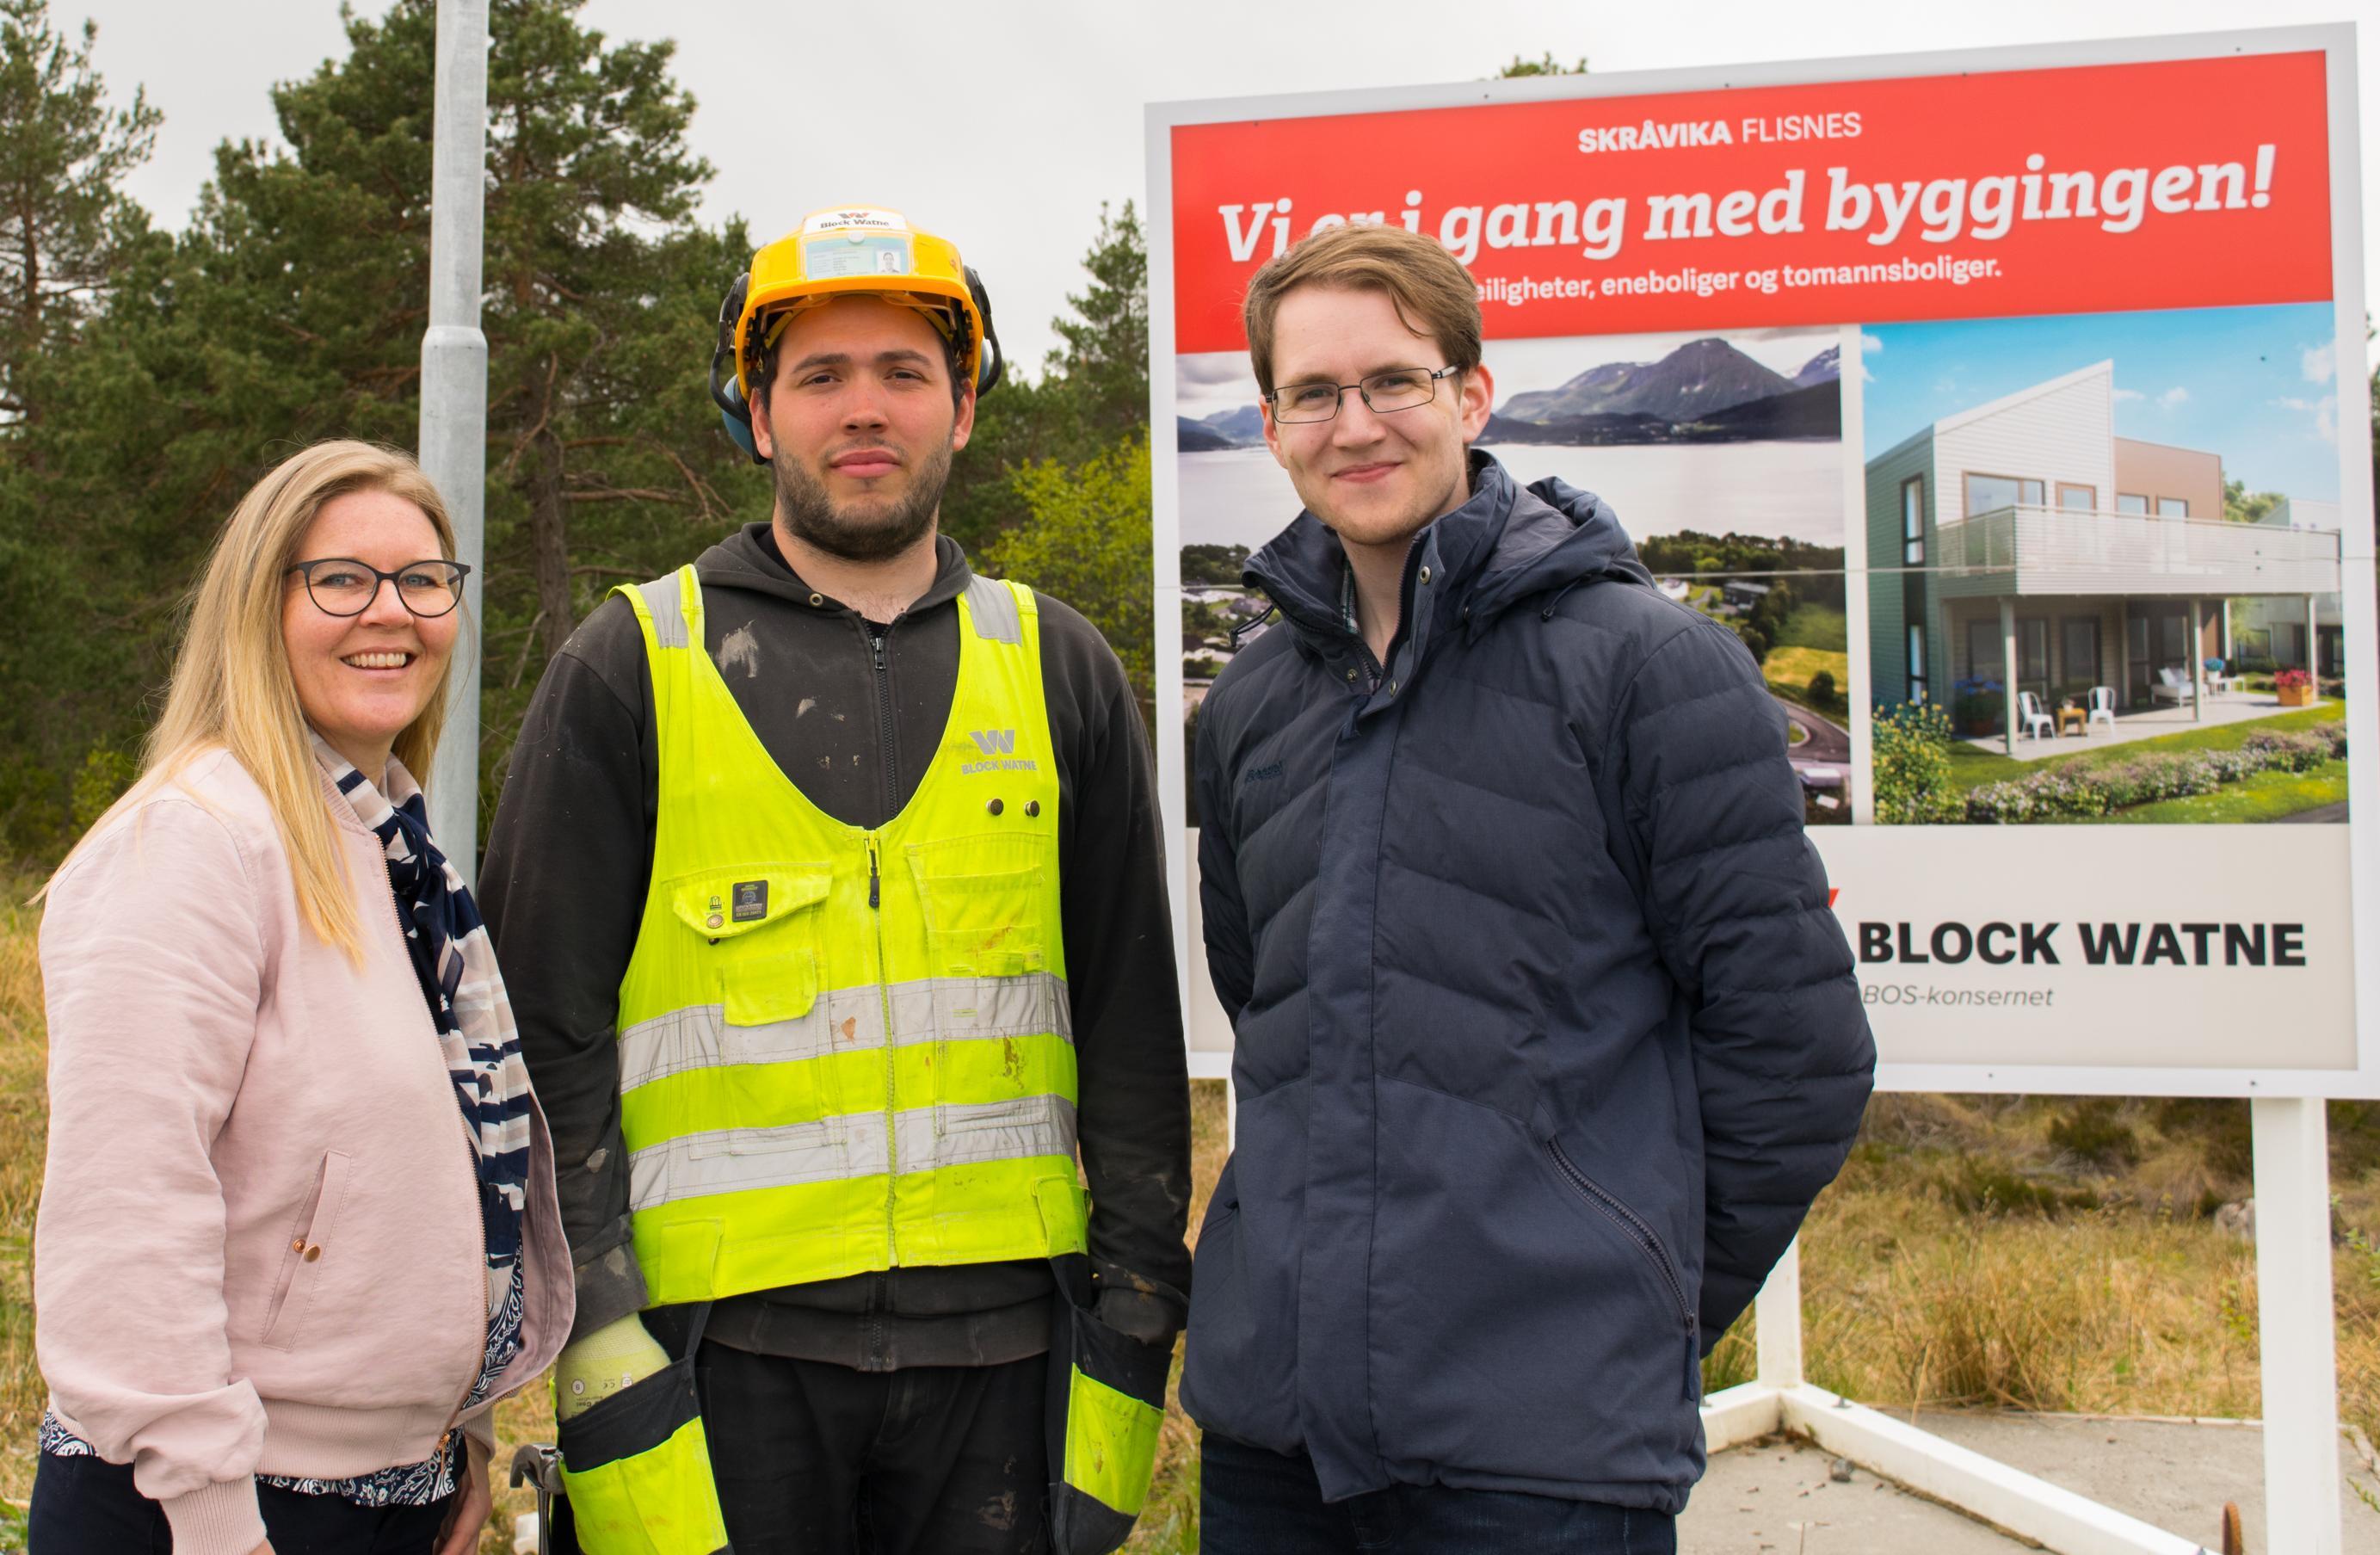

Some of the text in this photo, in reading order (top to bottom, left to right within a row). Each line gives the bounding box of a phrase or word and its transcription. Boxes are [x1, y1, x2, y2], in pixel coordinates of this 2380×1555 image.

[1578, 112, 1863, 153] SKRÅVIKA FLISNES
[820, 220, 850, 229] Block
[1218, 197, 1293, 262] Vi
[1439, 196, 1628, 267] gang
[1643, 169, 1806, 241] med
[1825, 143, 2277, 246] byggingen!
[1475, 255, 2004, 307] eiligheter, eneboliger og tomannsboliger.
[962, 760, 1037, 774] BLOCK WATNE
[1858, 921, 2307, 966] BLOCK WATNE
[1862, 984, 2055, 1007] BOS-konsernet
